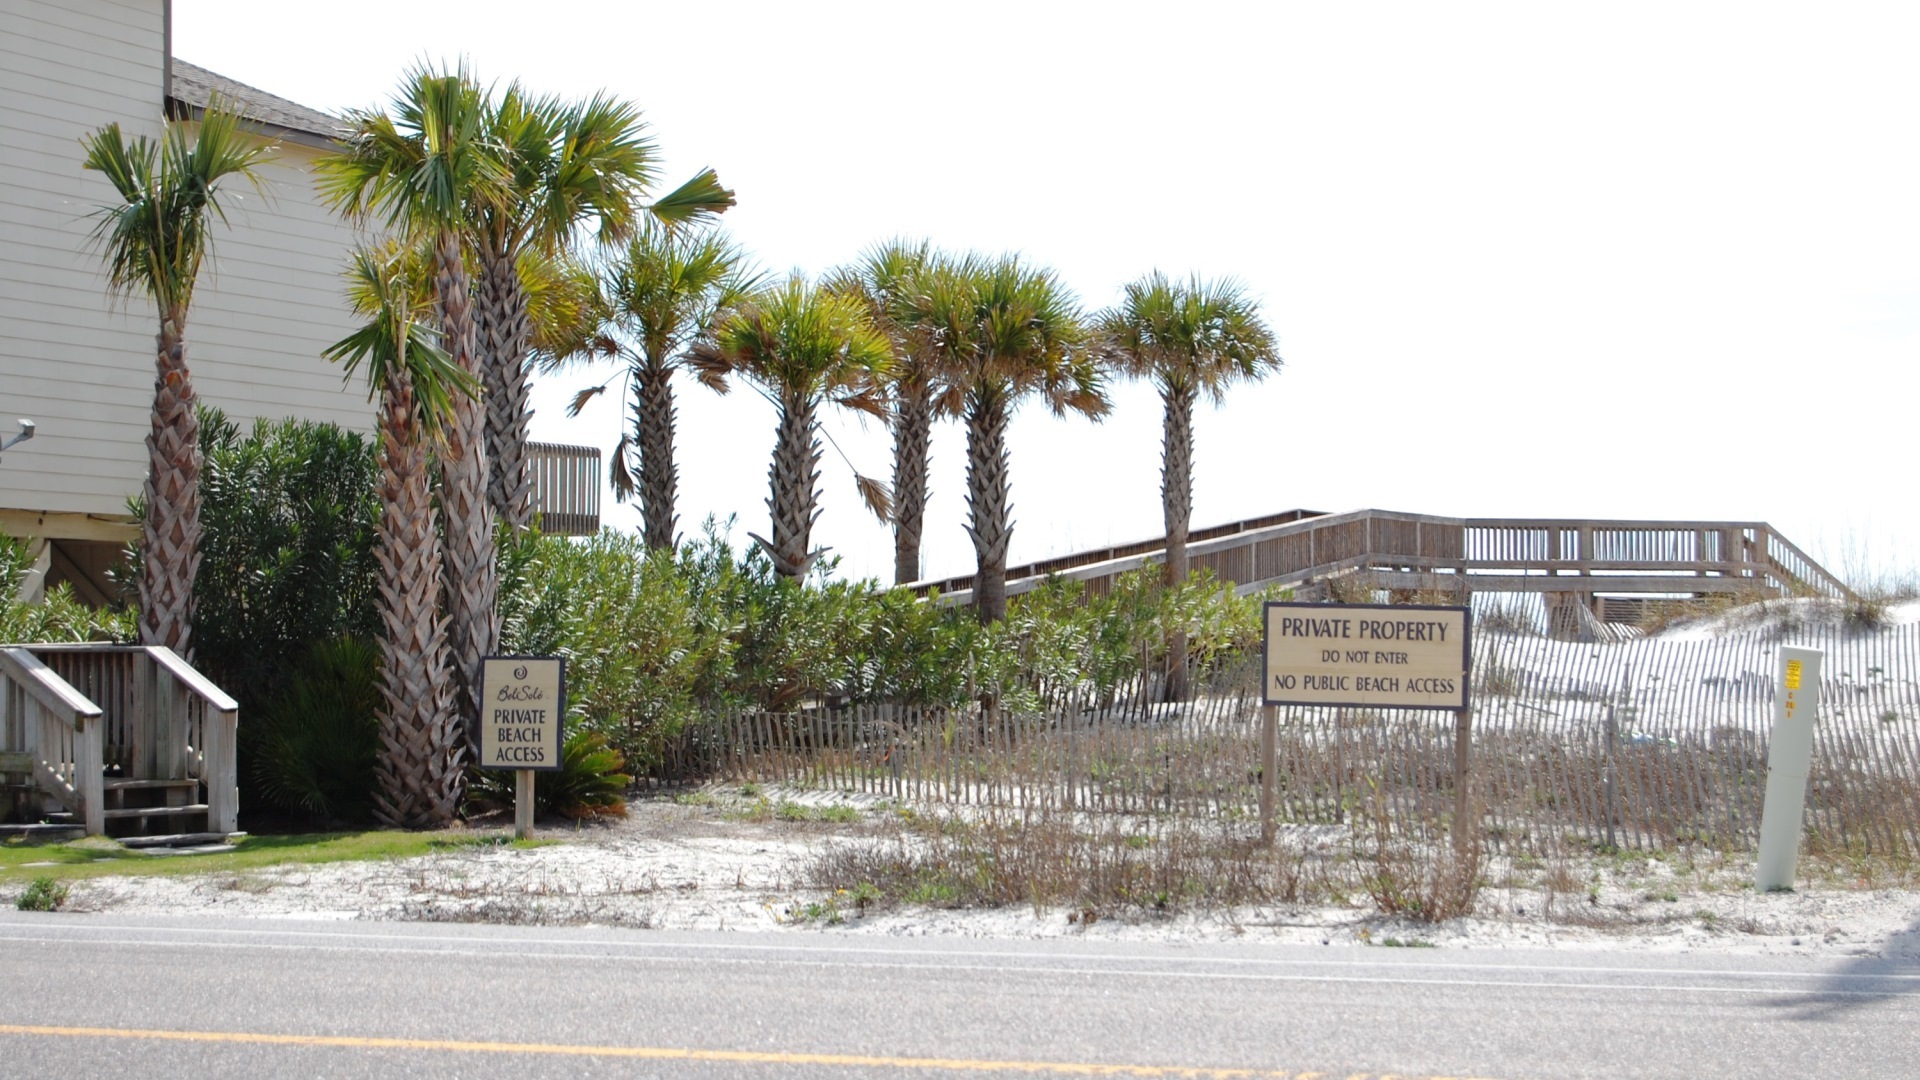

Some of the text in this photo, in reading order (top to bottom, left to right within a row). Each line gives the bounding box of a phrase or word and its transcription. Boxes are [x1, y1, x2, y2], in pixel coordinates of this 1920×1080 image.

[1282, 617, 1448, 641] PRIVATE PROPERTY
[1322, 650, 1408, 664] DO NOT ENTER
[1275, 675, 1454, 694] NO PUBLIC BEACH ACCESS
[494, 709, 546, 724] PRIVATE
[498, 728, 541, 742] BEACH
[496, 747, 545, 762] ACCESS
